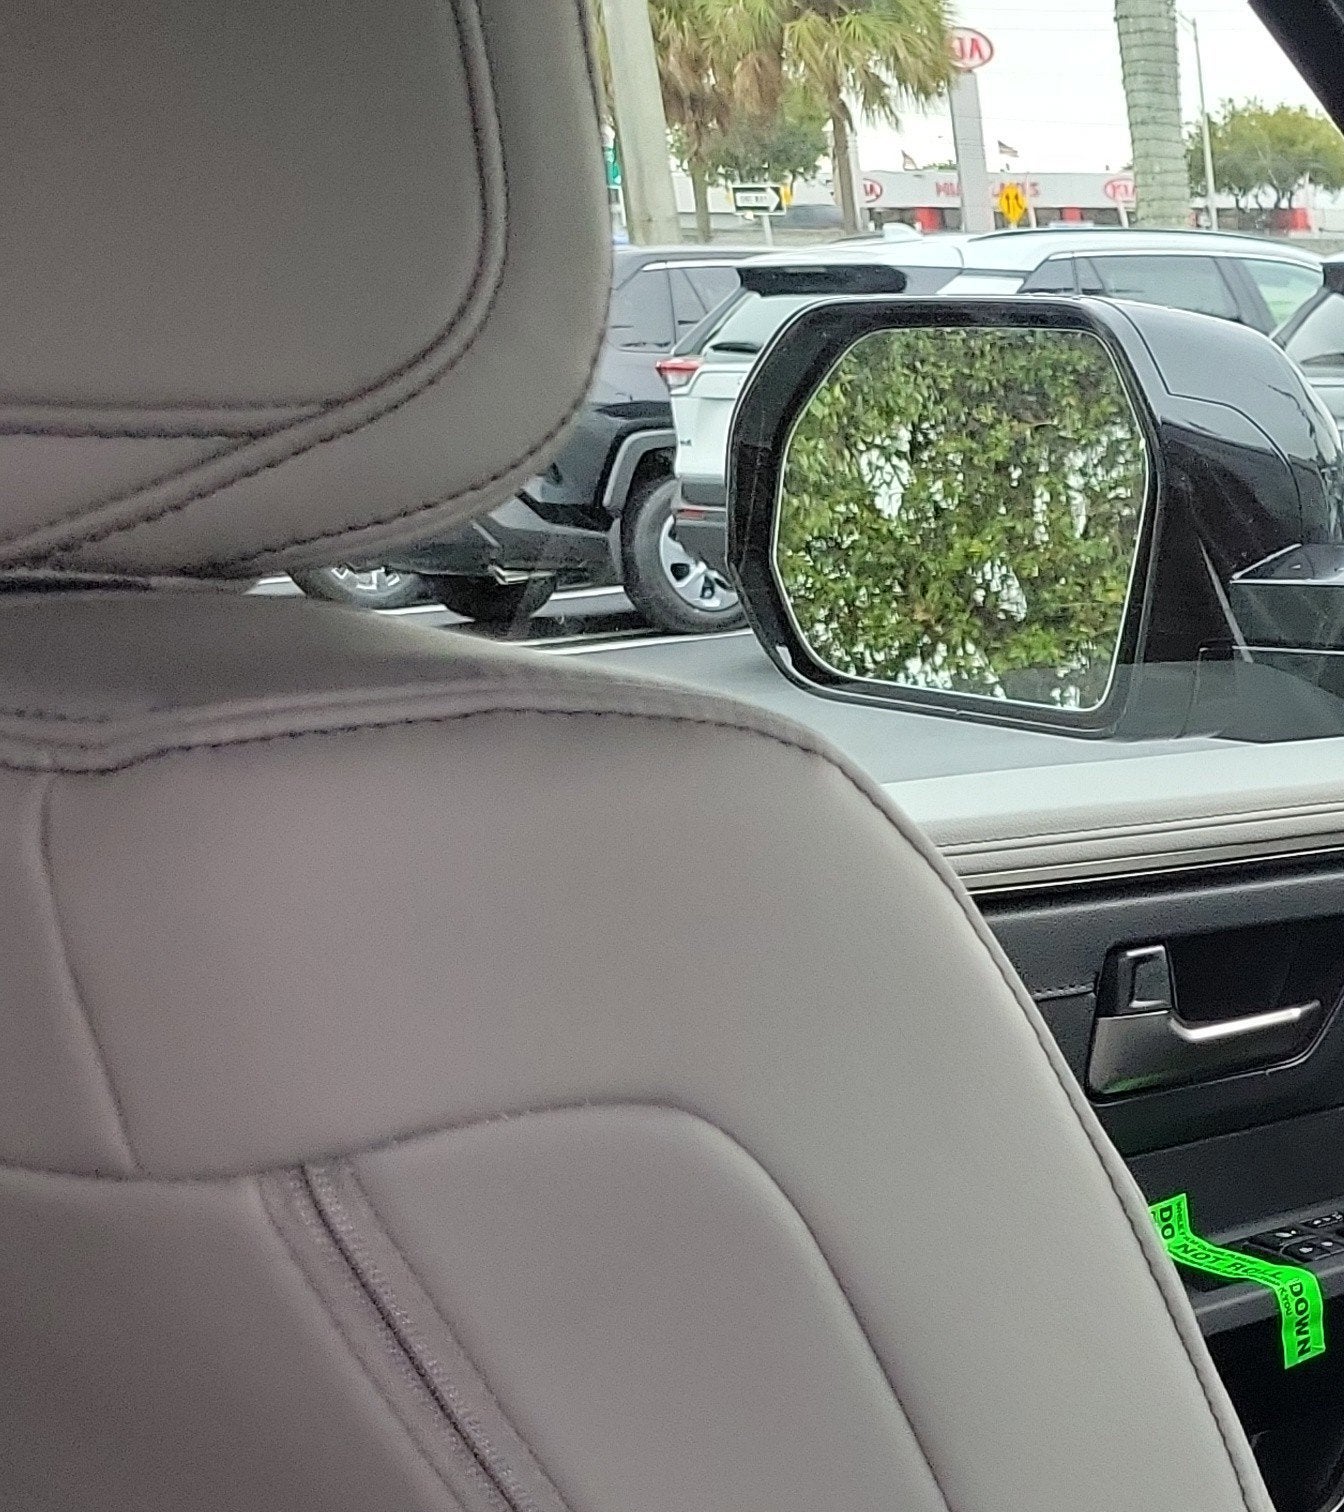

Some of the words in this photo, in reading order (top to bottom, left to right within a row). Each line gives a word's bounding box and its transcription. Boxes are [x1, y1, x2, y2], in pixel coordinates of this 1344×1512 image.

[1159, 1204, 1175, 1240] DO
[1175, 1243, 1224, 1265] NOT
[1287, 1280, 1312, 1358] DOWN
